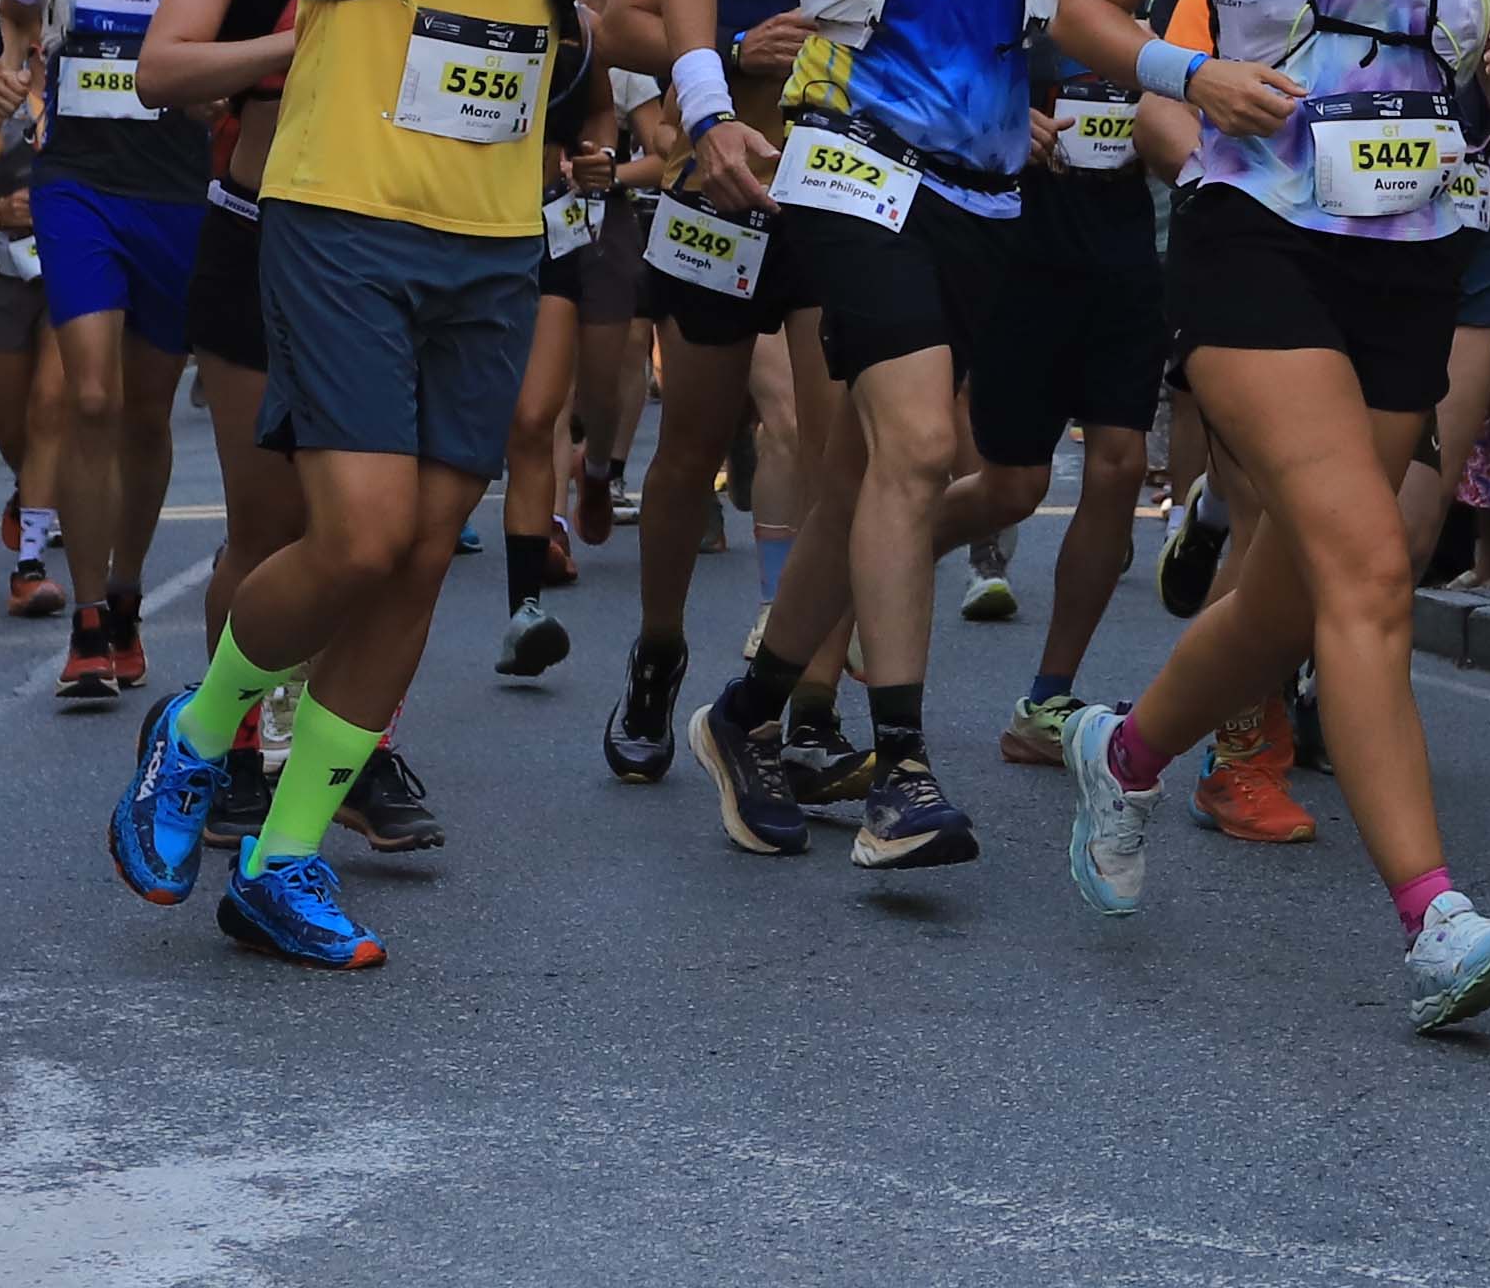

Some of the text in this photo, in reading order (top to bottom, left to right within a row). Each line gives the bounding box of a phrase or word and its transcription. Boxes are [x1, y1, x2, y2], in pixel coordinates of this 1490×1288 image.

[80, 72, 135, 91] 5488
[446, 67, 519, 101] 5556
[460, 102, 502, 120] Marco
[1093, 141, 1127, 153] Florent
[1358, 142, 1432, 171] 5447
[810, 147, 882, 187] 5372
[800, 174, 877, 202] Jean Philippe
[1374, 177, 1419, 191] Aurore
[1447, 176, 1475, 197] 40
[669, 220, 732, 258] 5249
[674, 249, 712, 271] Joseph
[135, 740, 167, 802] HOKA
